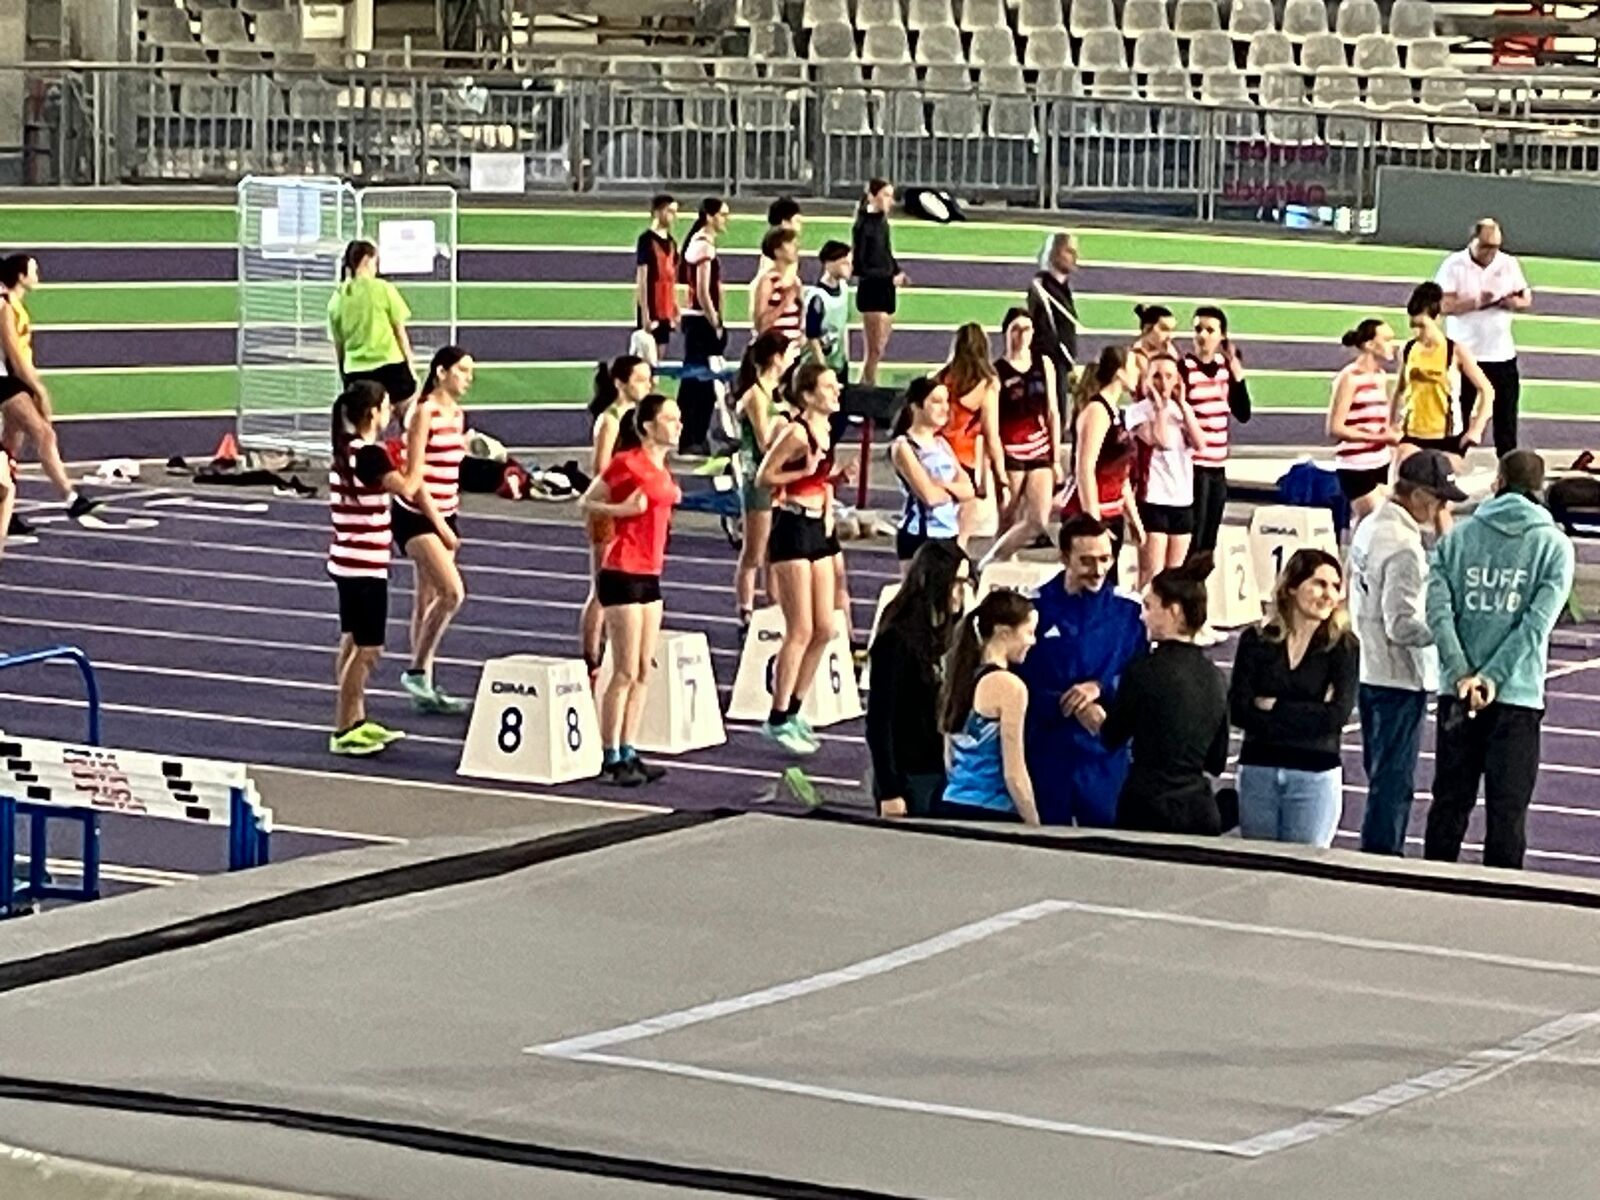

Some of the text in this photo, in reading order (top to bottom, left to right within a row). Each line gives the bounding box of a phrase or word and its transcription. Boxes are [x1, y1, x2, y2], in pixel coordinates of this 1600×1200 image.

[491, 681, 538, 698] DIMA
[829, 653, 840, 694] 6
[685, 679, 697, 723] 7
[498, 706, 523, 754] 8
[567, 706, 582, 752] 8
